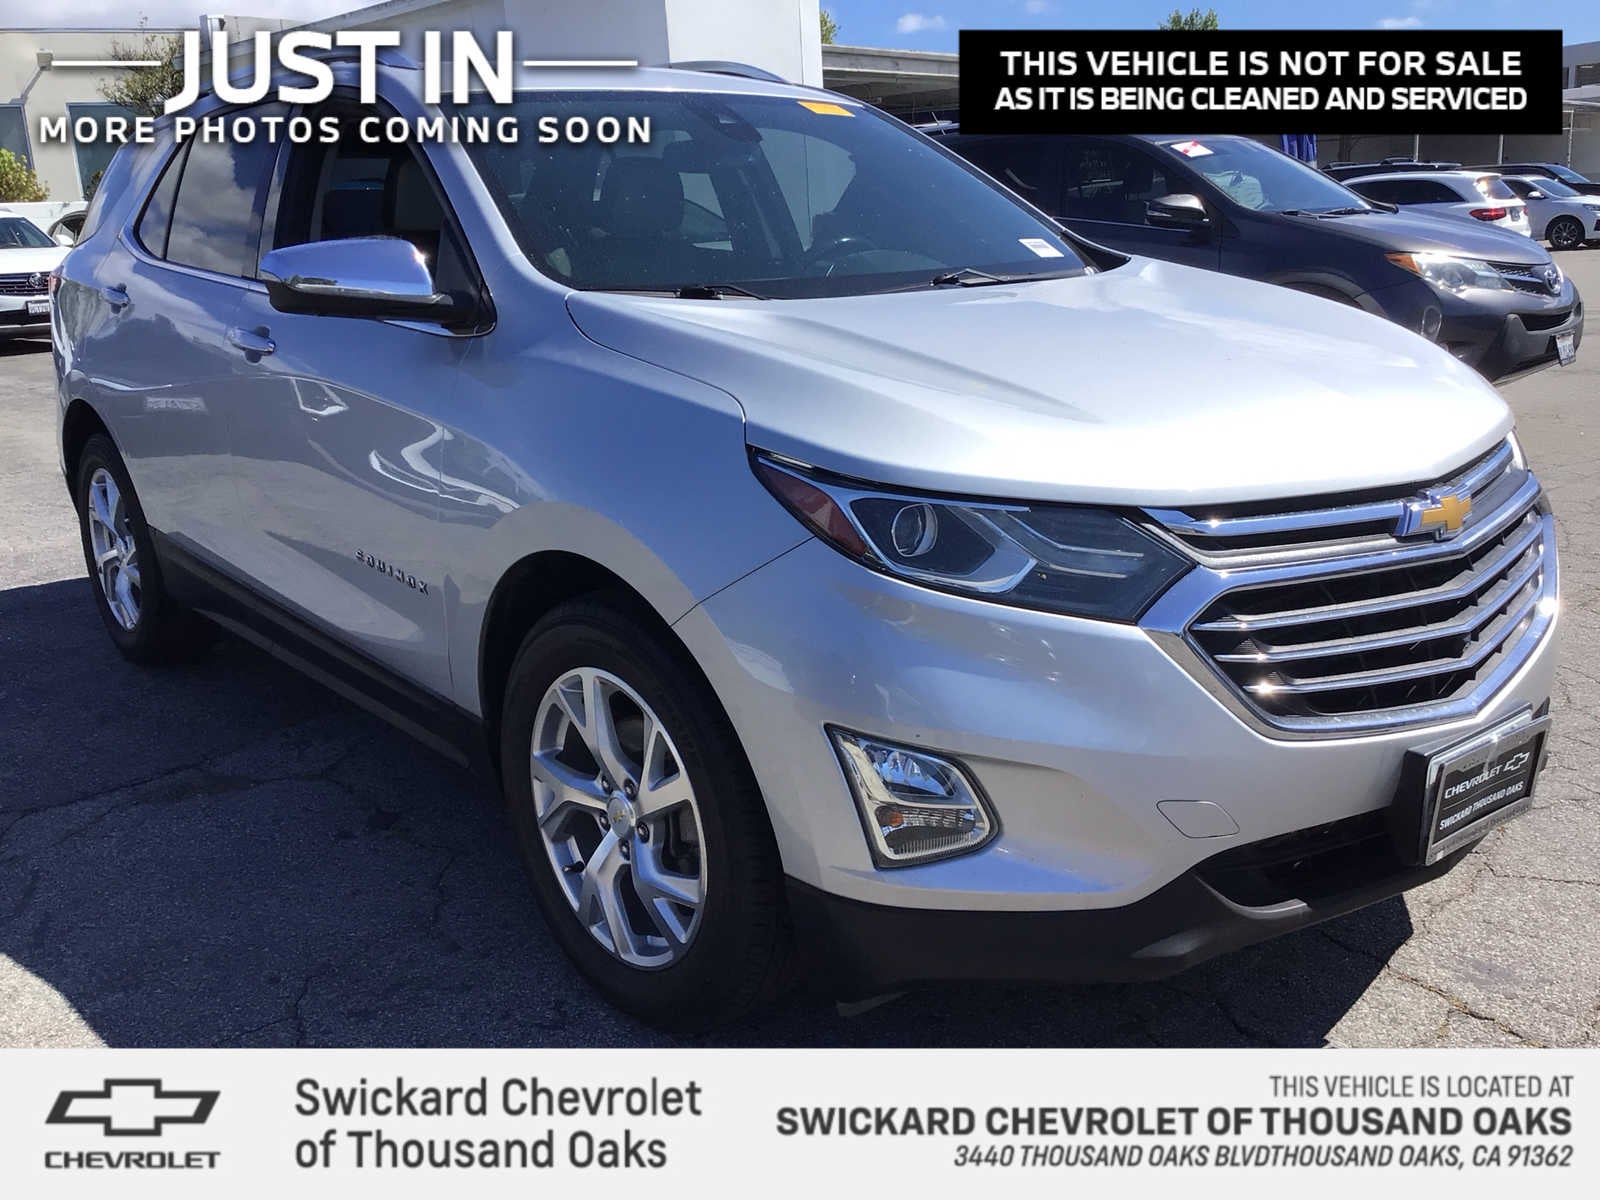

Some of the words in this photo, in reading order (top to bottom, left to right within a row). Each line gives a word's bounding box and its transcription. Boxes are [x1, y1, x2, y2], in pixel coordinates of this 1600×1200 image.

[355, 549, 429, 596] EQUINOX
[1444, 764, 1503, 799] CHEVROLET
[1506, 780, 1524, 796] OAKS
